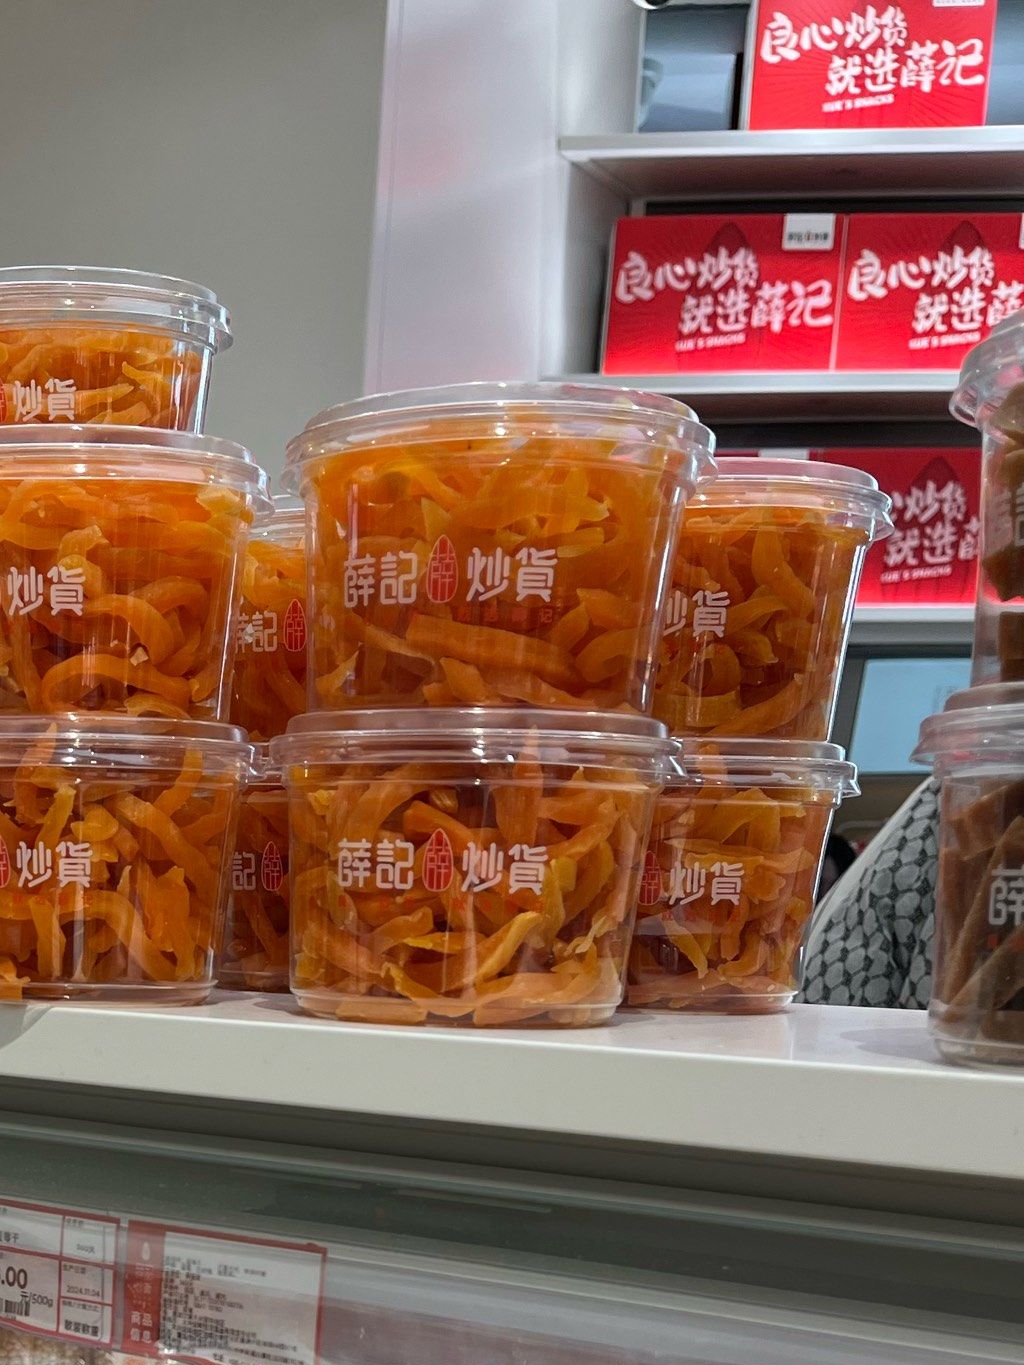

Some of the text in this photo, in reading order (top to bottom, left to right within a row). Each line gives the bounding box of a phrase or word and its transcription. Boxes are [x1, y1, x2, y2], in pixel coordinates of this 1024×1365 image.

[760, 5, 907, 63] 良心炒货
[825, 39, 985, 95] 就选薛记
[616, 247, 759, 302] 良心炒货
[847, 245, 995, 301] 良心炒货
[679, 279, 834, 334] 就选薛记
[13, 378, 77, 422] 炒貨
[7, 566, 86, 616] 炒貨
[344, 550, 418, 608] 薛記
[466, 547, 558, 602] 炒貨
[16, 841, 93, 888] 炒貨
[338, 838, 415, 890] 薛記
[461, 841, 549, 895] 炒貨
[669, 861, 745, 905] 炒貨
